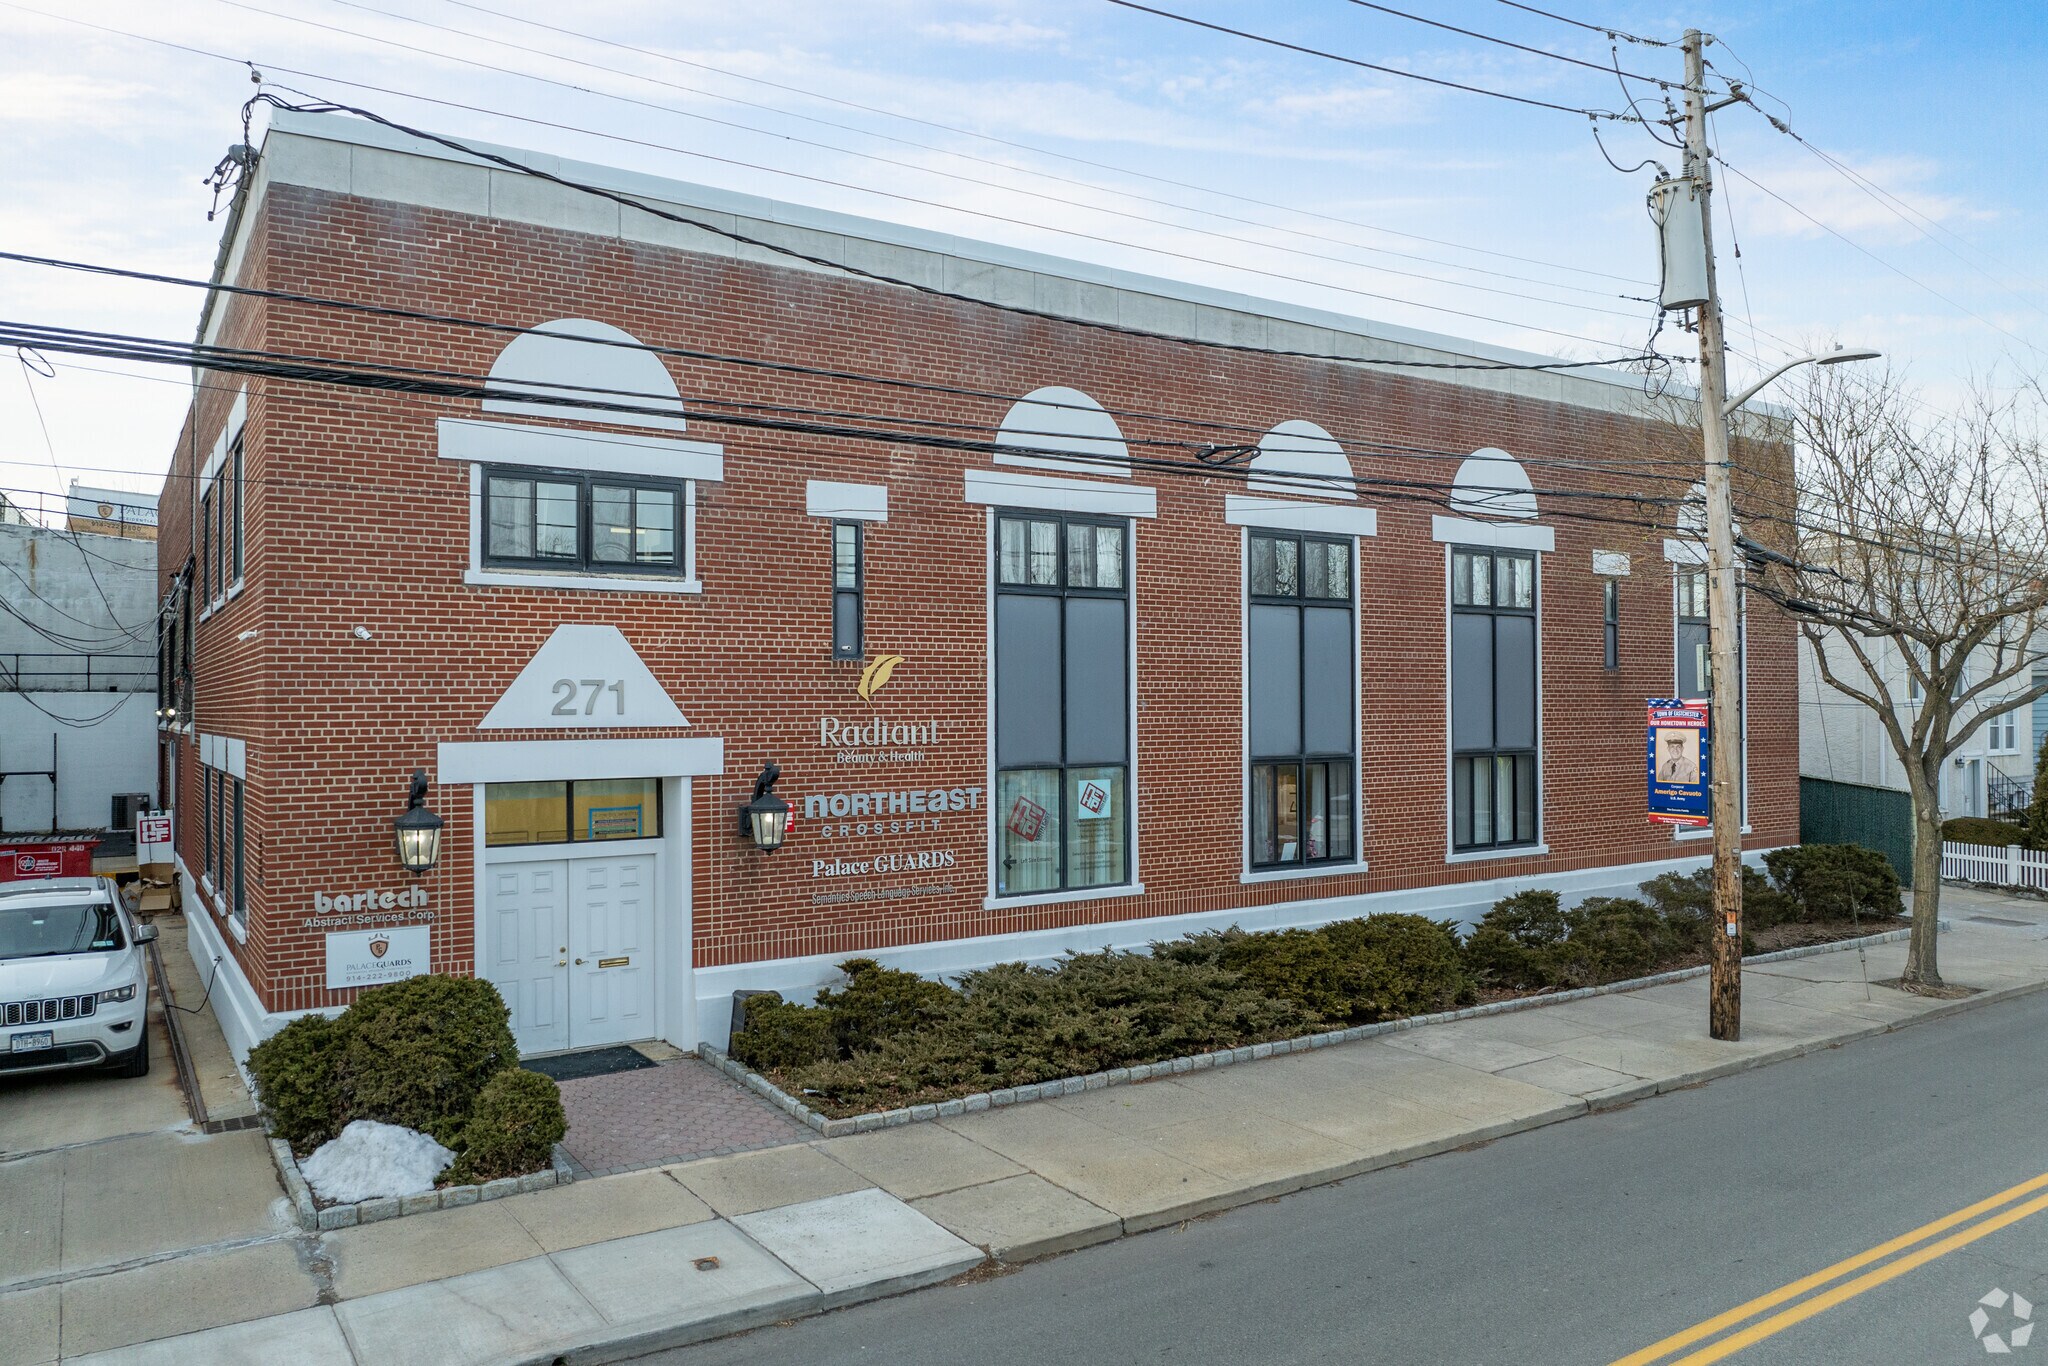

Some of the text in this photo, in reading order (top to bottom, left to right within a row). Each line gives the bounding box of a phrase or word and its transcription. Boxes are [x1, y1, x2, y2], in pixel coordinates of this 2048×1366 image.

[551, 678, 625, 716] 271
[820, 717, 940, 747] Radiant
[836, 750, 925, 768] Beauty & Health
[1654, 788, 1677, 796] Amerigo
[821, 819, 940, 838] CROSSFIT
[811, 850, 955, 878] Palace GUARDS
[314, 884, 428, 914] bartech
[811, 891, 849, 905] Semantics
[304, 909, 436, 928] Abstract Services Corp.
[346, 970, 411, 982] 914-222-9800
